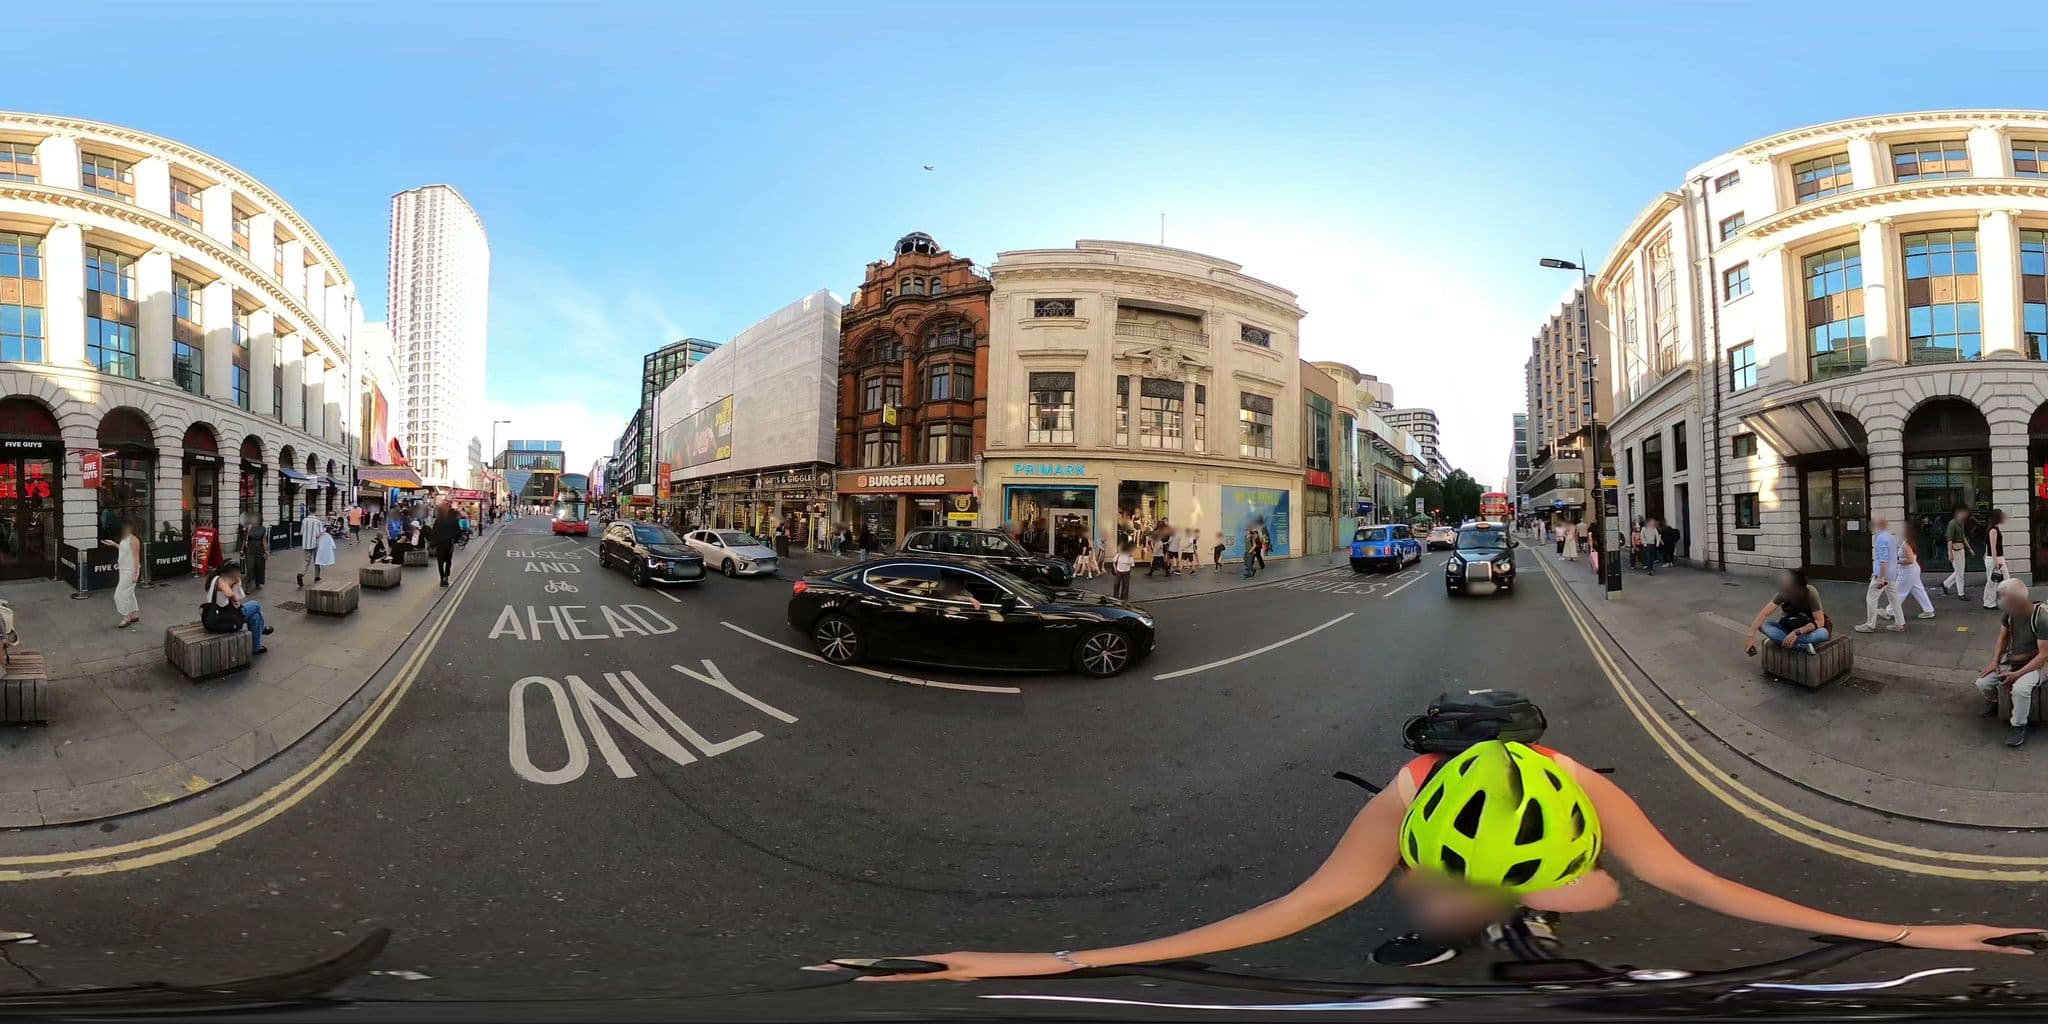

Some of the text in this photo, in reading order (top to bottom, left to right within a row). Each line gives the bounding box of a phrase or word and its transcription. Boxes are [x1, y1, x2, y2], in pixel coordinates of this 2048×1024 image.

[84, 461, 97, 471] FIVE
[1014, 463, 1086, 476] PRIMARK
[83, 470, 98, 480] GUYS
[868, 474, 912, 487] BURGER
[913, 473, 945, 486] KING
[172, 555, 187, 564] GUYS
[506, 549, 582, 560] BUSES
[94, 564, 112, 573] FIVE
[524, 561, 581, 574] AND
[488, 604, 680, 641] AHEAD
[508, 658, 799, 786] ONLY
